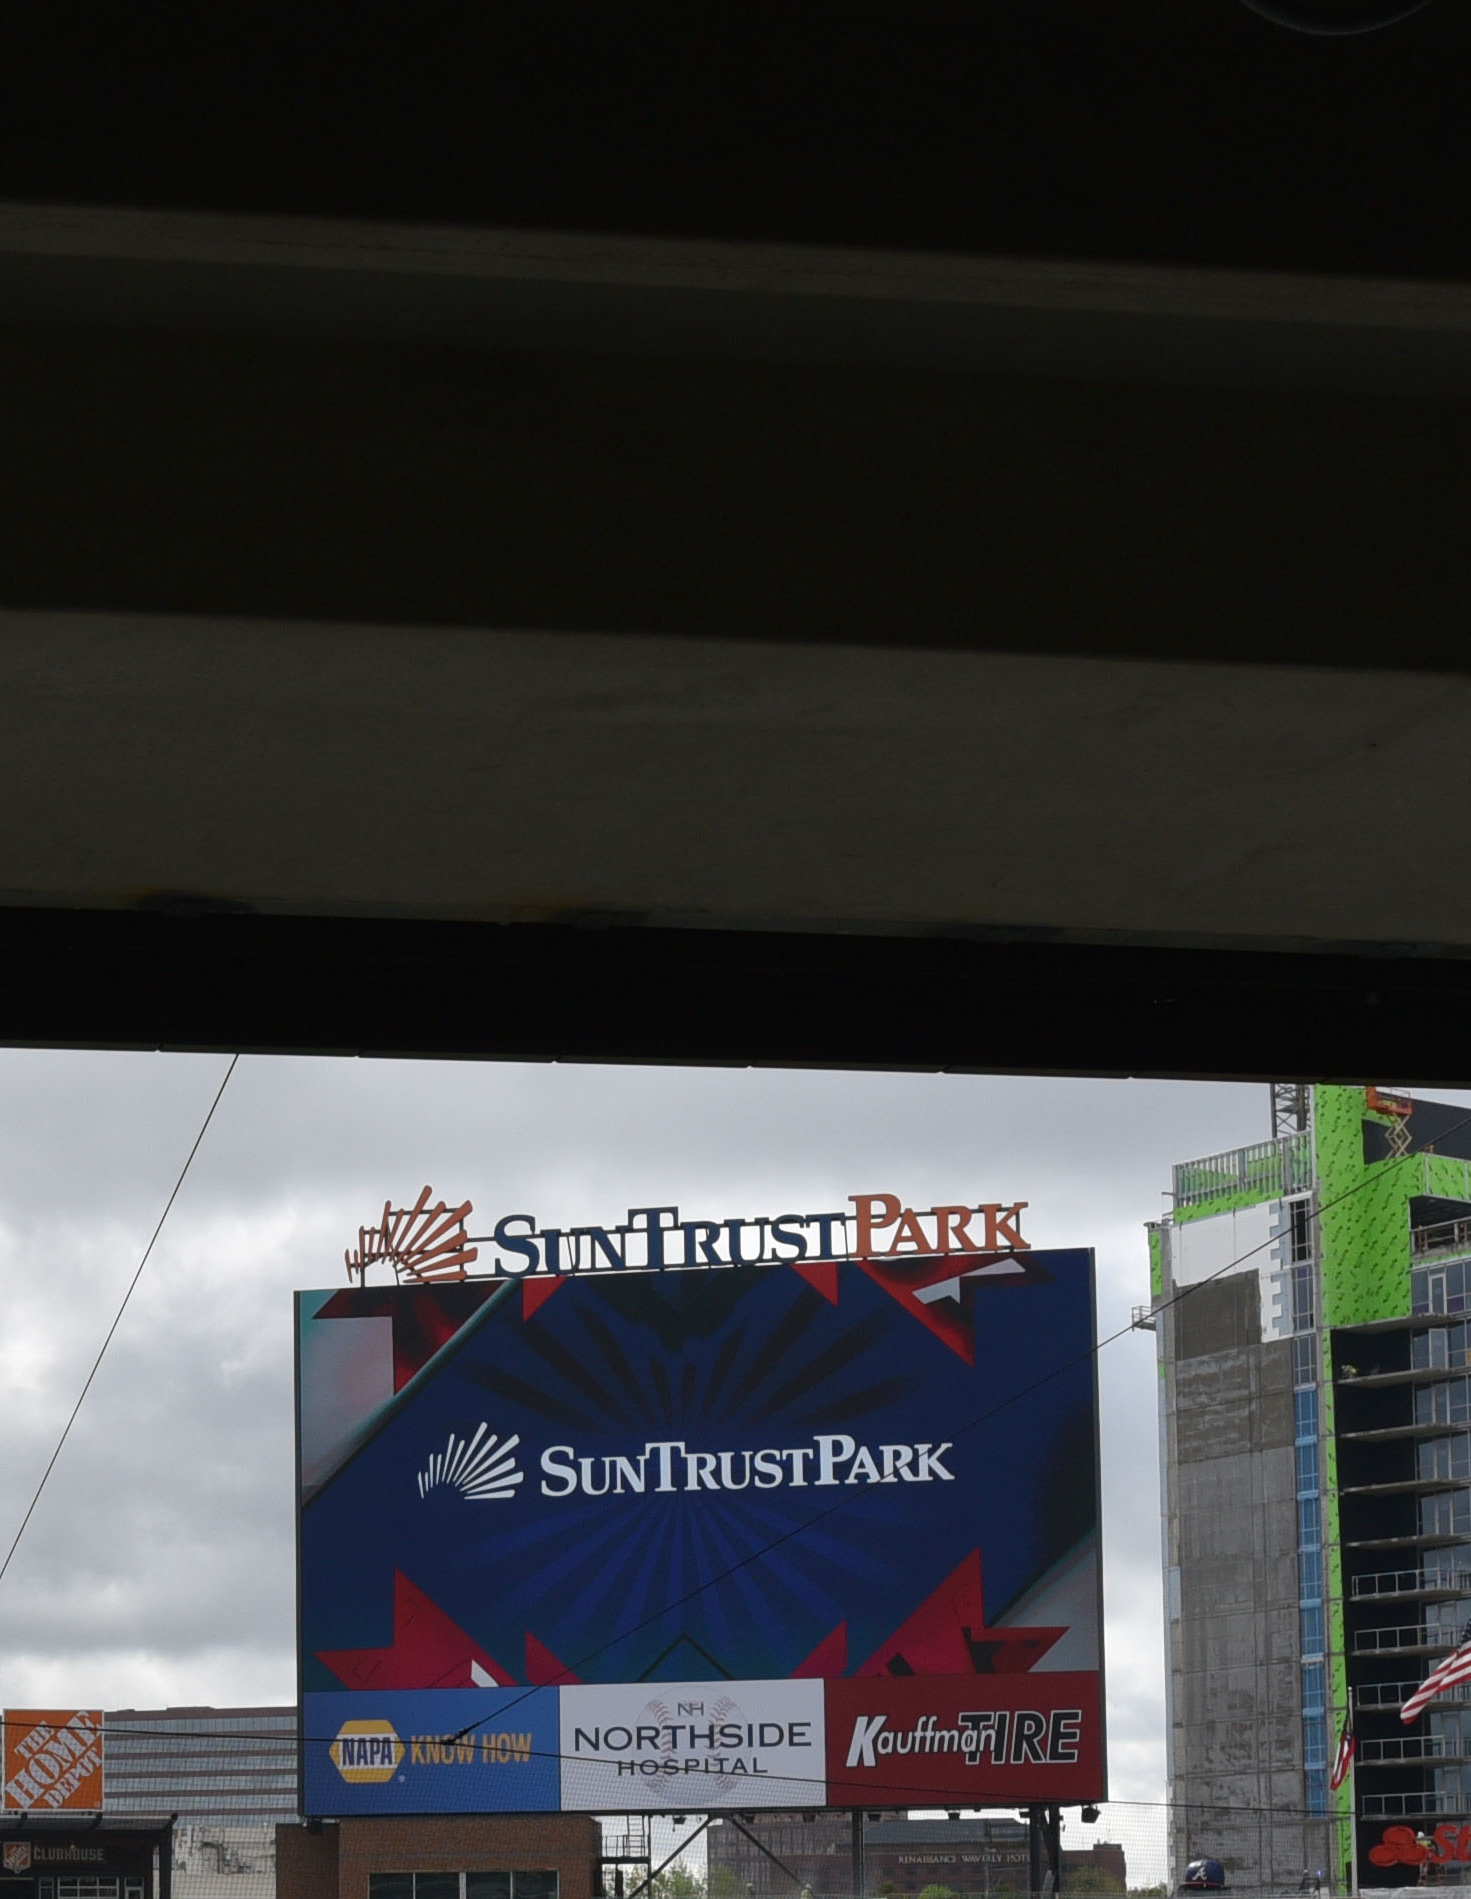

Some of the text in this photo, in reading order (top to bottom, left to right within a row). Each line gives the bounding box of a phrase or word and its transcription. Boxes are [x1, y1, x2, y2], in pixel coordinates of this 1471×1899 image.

[341, 1736, 394, 1767] NAPA
[411, 1732, 533, 1766] KNOW HOW
[573, 1722, 813, 1753] NORTHSIDE
[846, 1709, 1083, 1769] Kauffman TIRE
[5, 1710, 103, 1810] THE HOME DEPOT
[617, 1757, 769, 1778] HOSPITAL
[33, 1845, 105, 1862] CLUBHOUSE
